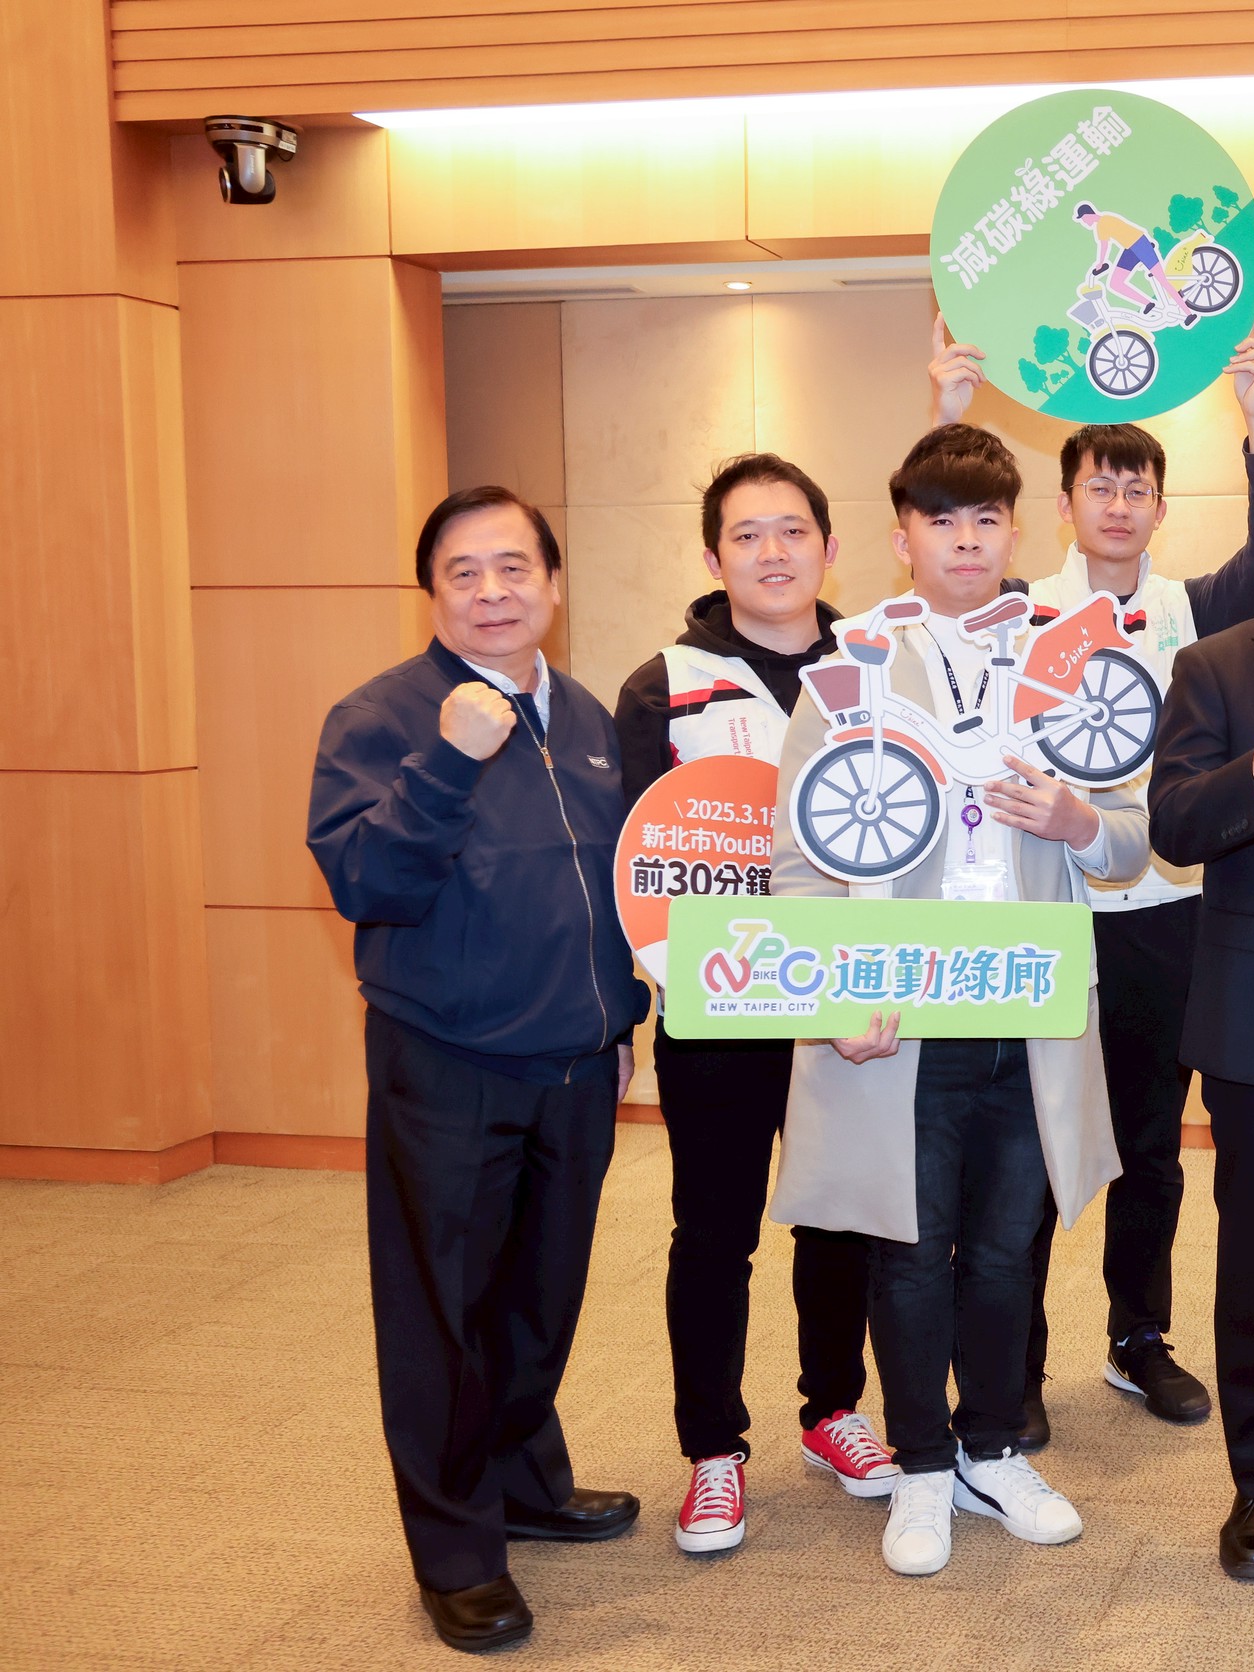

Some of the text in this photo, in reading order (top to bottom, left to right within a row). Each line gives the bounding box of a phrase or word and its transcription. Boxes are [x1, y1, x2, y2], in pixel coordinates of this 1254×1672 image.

[940, 106, 1132, 289] 減碳綠運輸
[753, 970, 778, 980] BIKE
[832, 947, 1055, 1003] 通勤綠廊
[711, 1003, 815, 1012] NEW TAIPEI CITY
